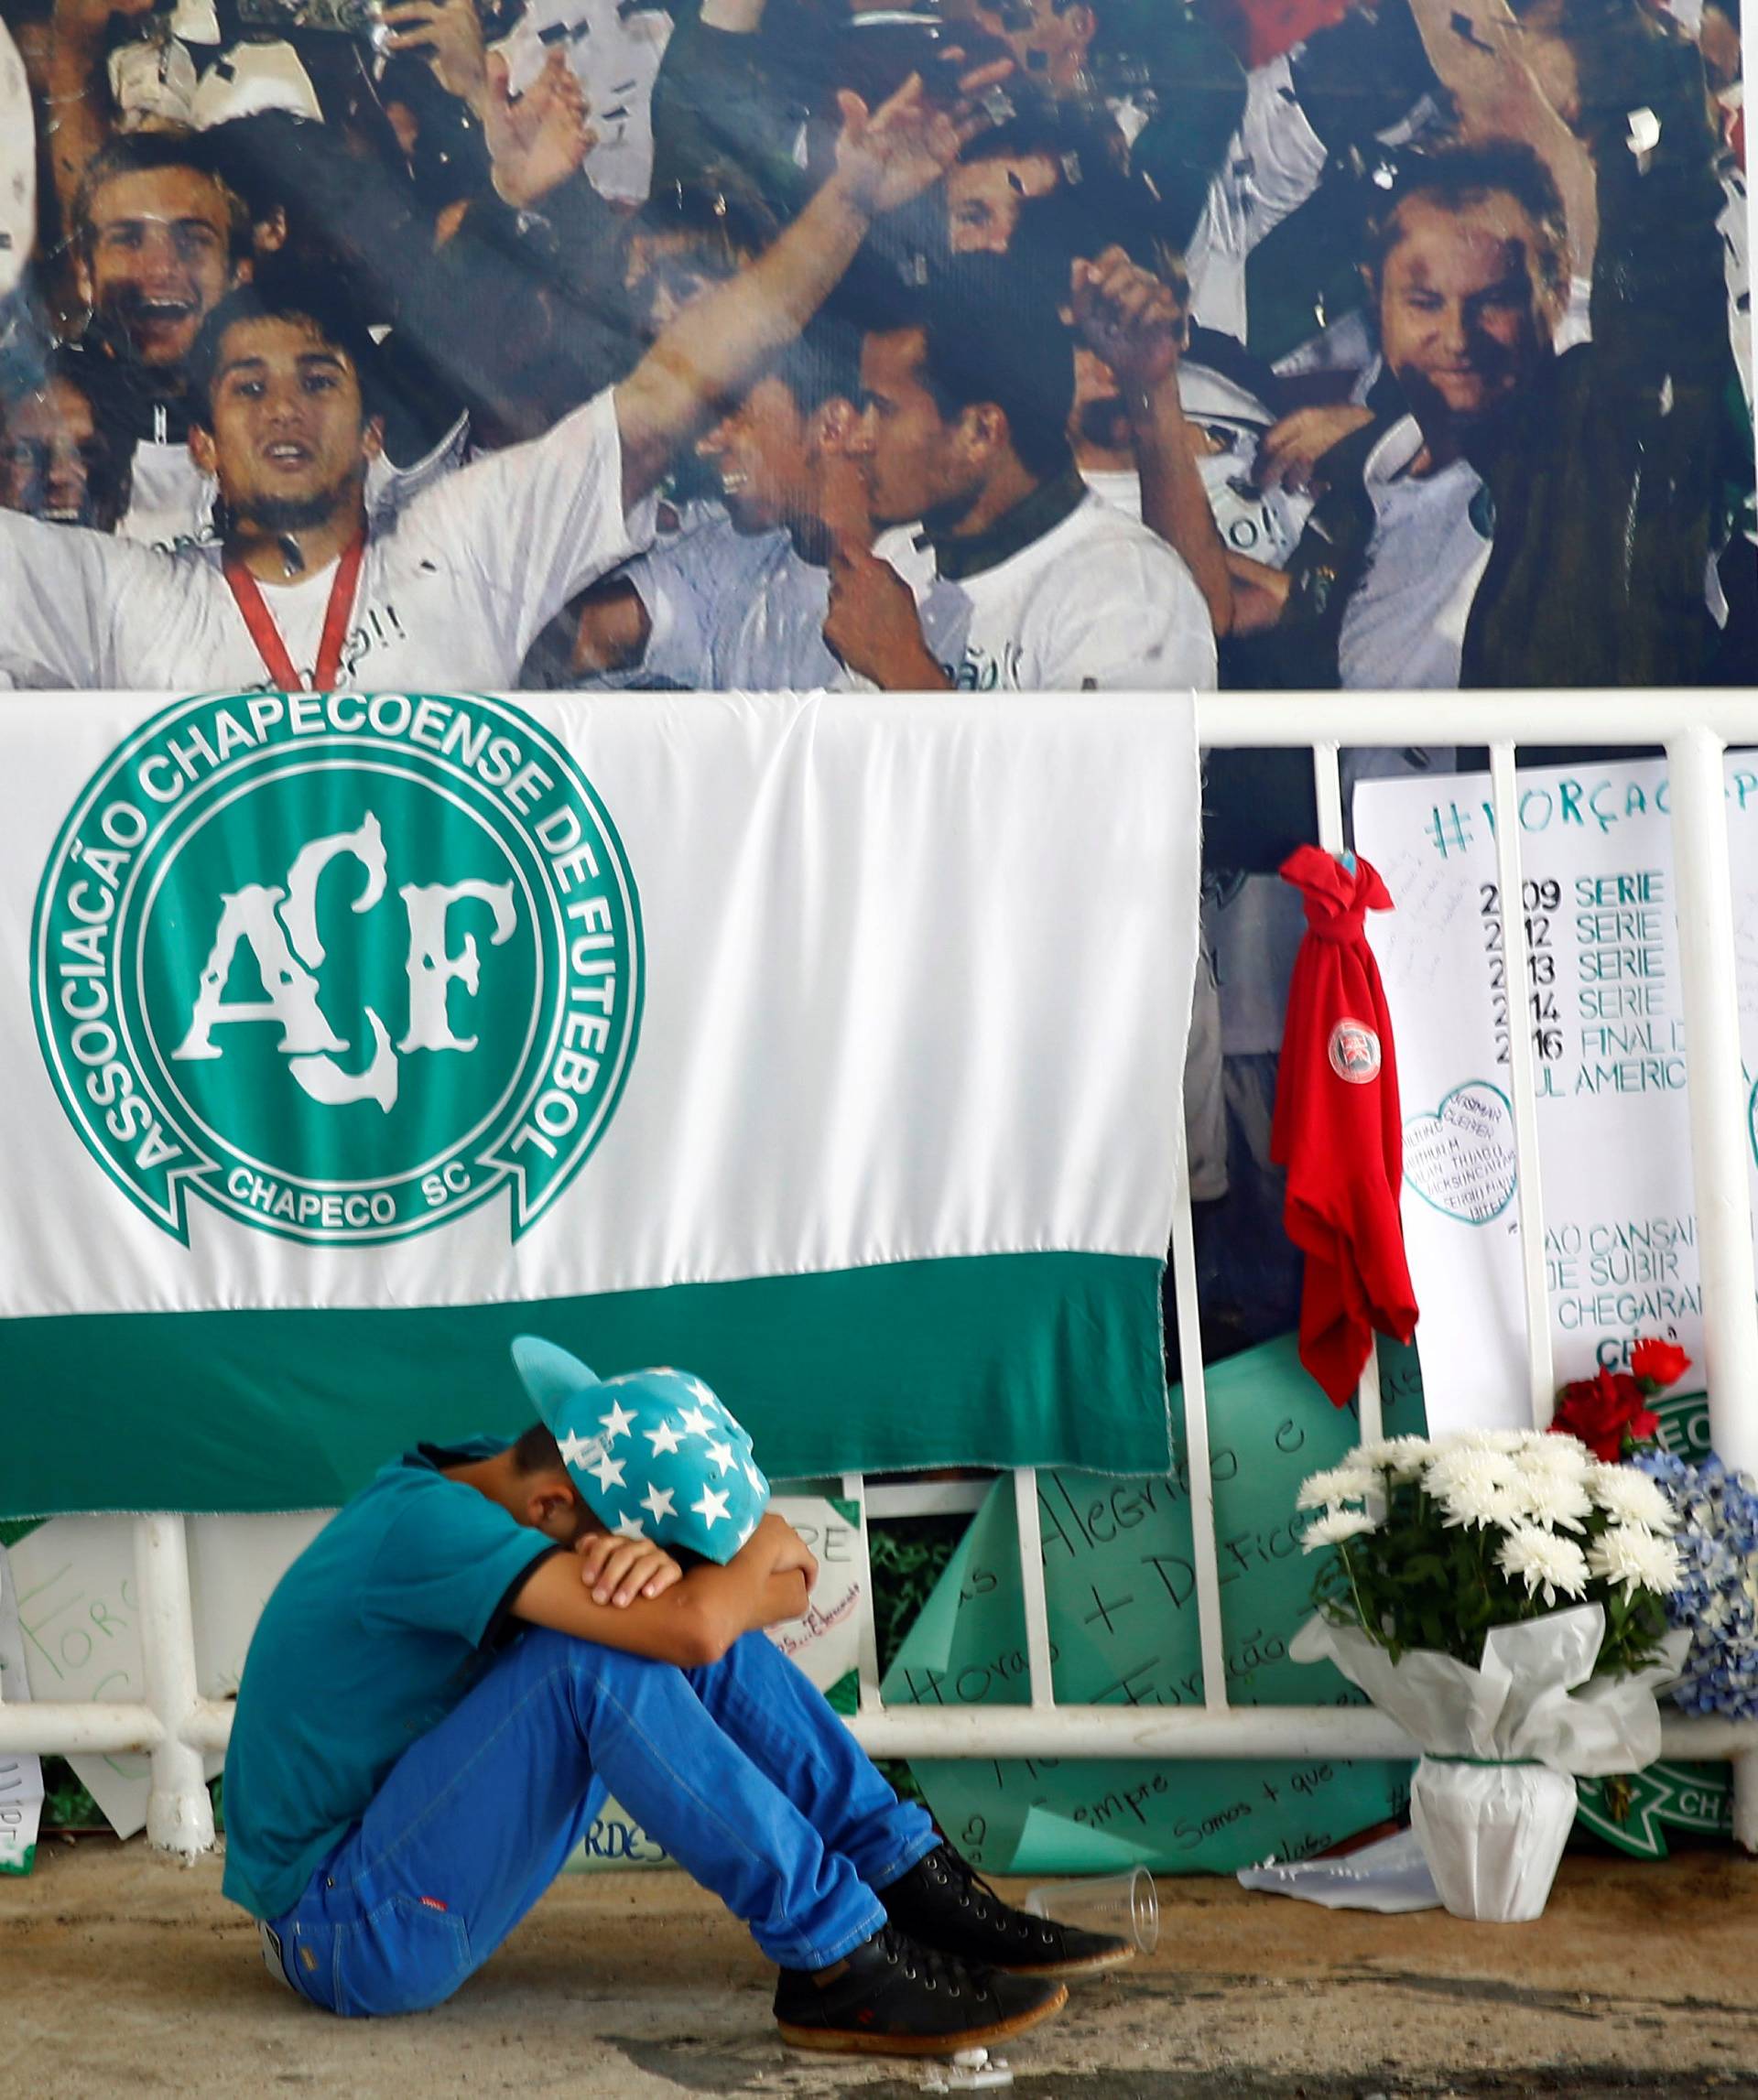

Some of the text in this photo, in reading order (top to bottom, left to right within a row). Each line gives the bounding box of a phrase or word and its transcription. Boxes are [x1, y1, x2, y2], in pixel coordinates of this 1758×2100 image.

[138, 692, 556, 803] CHAPECOENSE
[535, 804, 602, 893] DE
[1481, 871, 1665, 916] 209 SERIE
[1485, 916, 1552, 951] 212
[1577, 908, 1663, 945] SERIE
[1489, 945, 1665, 989] 213 SERIE
[1492, 982, 1665, 1027] 214 SERIE
[511, 896, 616, 1159] FUTEBOL
[1496, 1028, 1563, 1065] 216
[1581, 1022, 1665, 1057] FINAL
[1576, 1057, 1687, 1096] AMERIC
[226, 1162, 472, 1228] CHAPECO SC
[1590, 1216, 1697, 1256] CANSA
[1590, 1250, 1679, 1285] SUBIR
